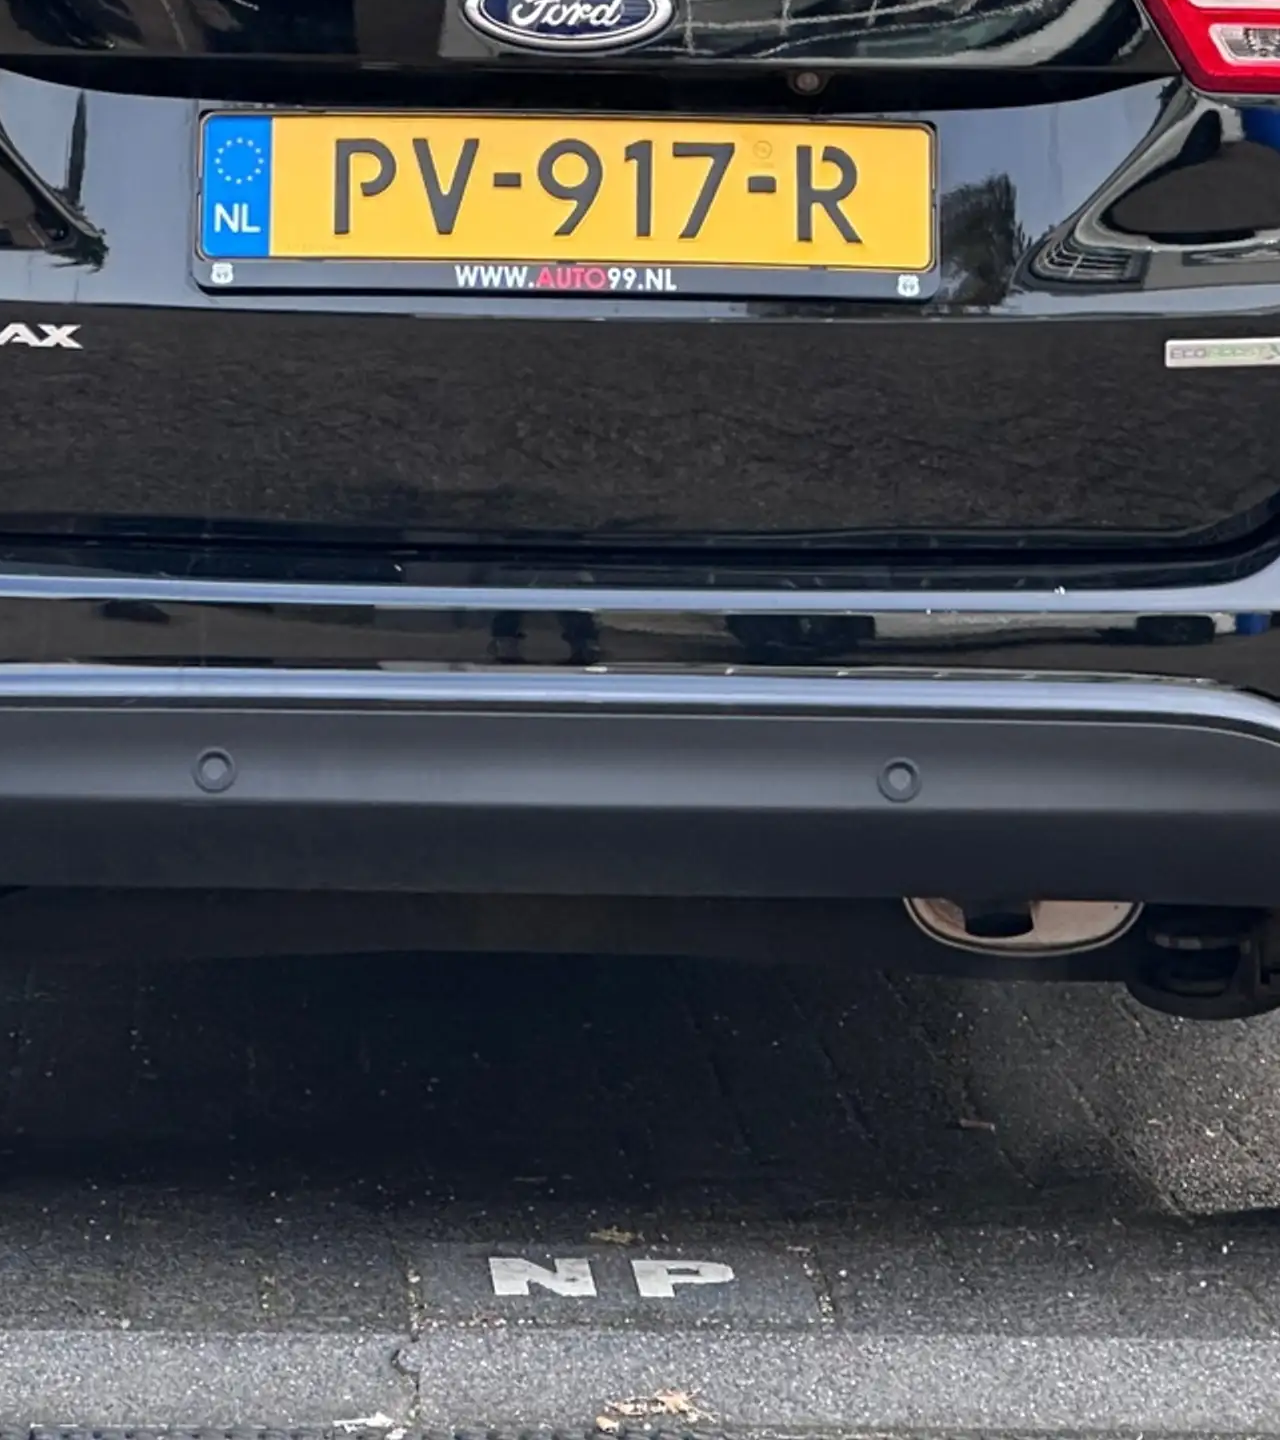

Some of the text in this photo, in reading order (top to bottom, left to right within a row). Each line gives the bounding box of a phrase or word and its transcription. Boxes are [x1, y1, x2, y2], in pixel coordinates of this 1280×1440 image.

[333, 137, 863, 244] PV-917-R
[214, 203, 262, 233] NL
[454, 265, 678, 292] WWW.AUTO99.NL
